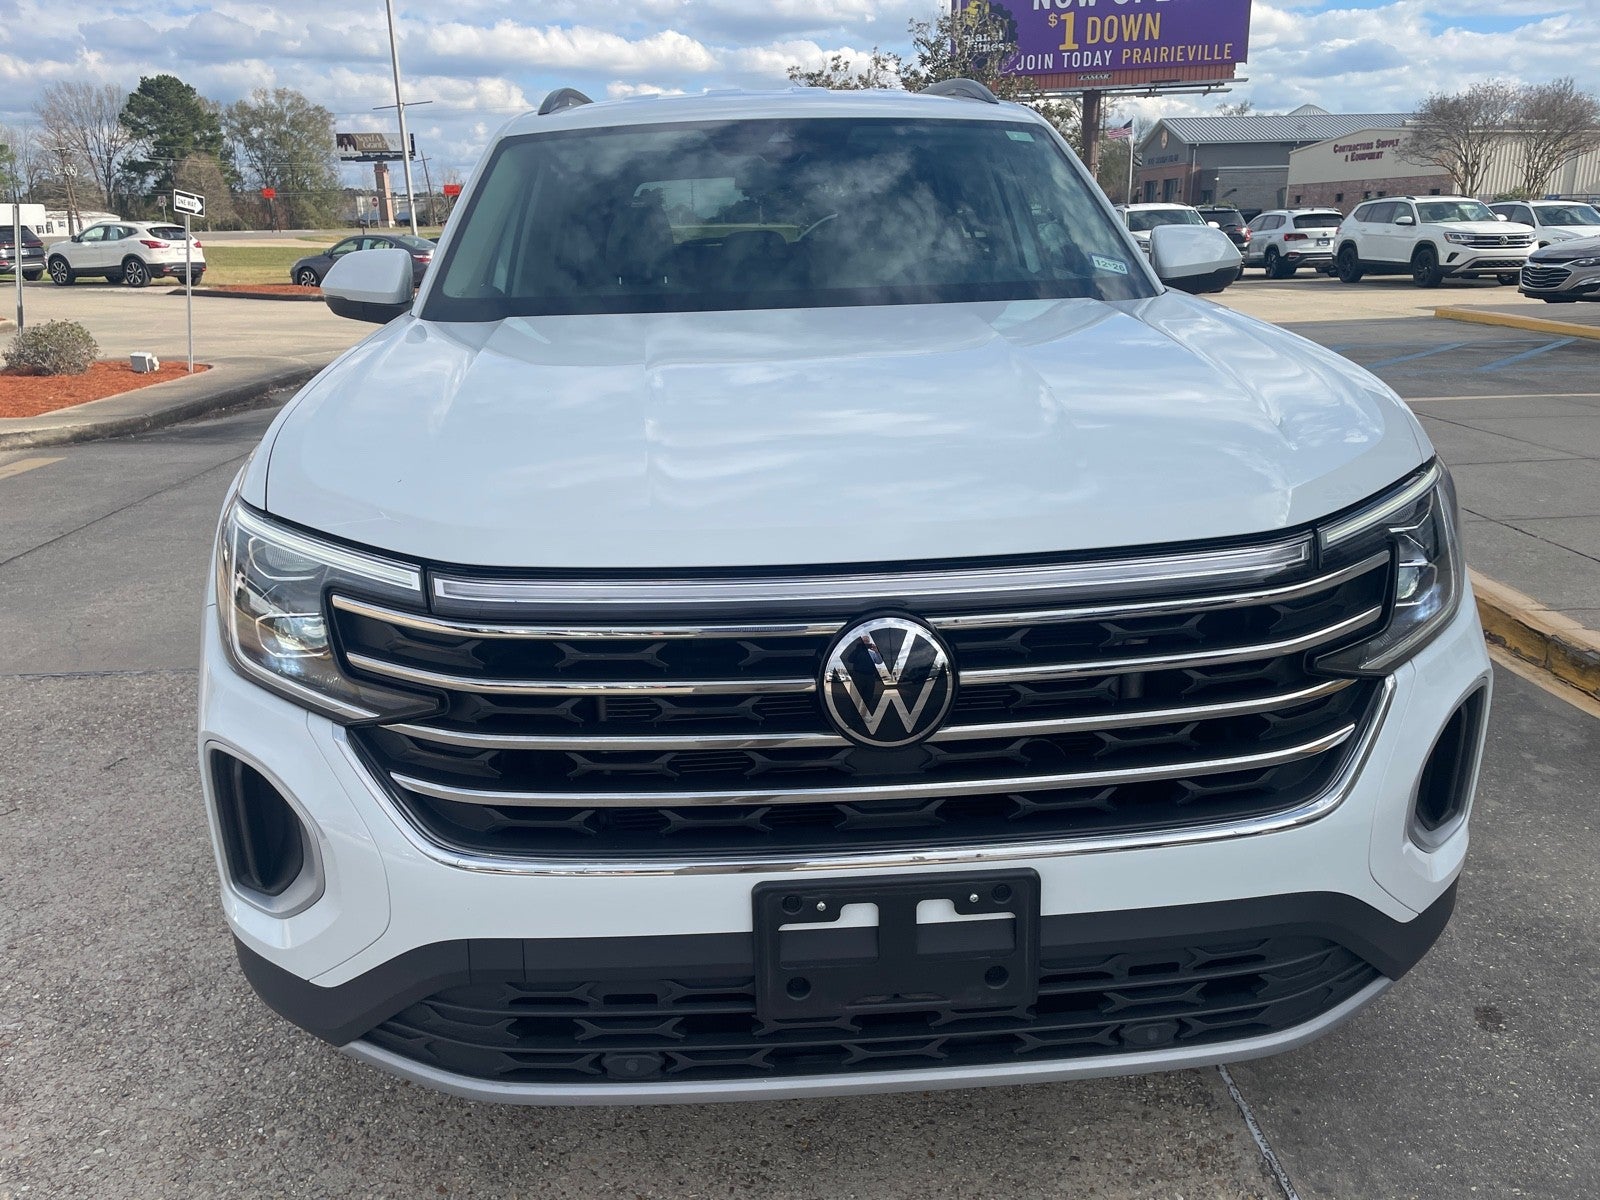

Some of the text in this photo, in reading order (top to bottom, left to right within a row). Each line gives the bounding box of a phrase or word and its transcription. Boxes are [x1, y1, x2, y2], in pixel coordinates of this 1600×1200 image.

[1048, 11, 1161, 50] $1 DOWN
[1016, 43, 1233, 71] JOIN TODAY PRAIRIEVILLE
